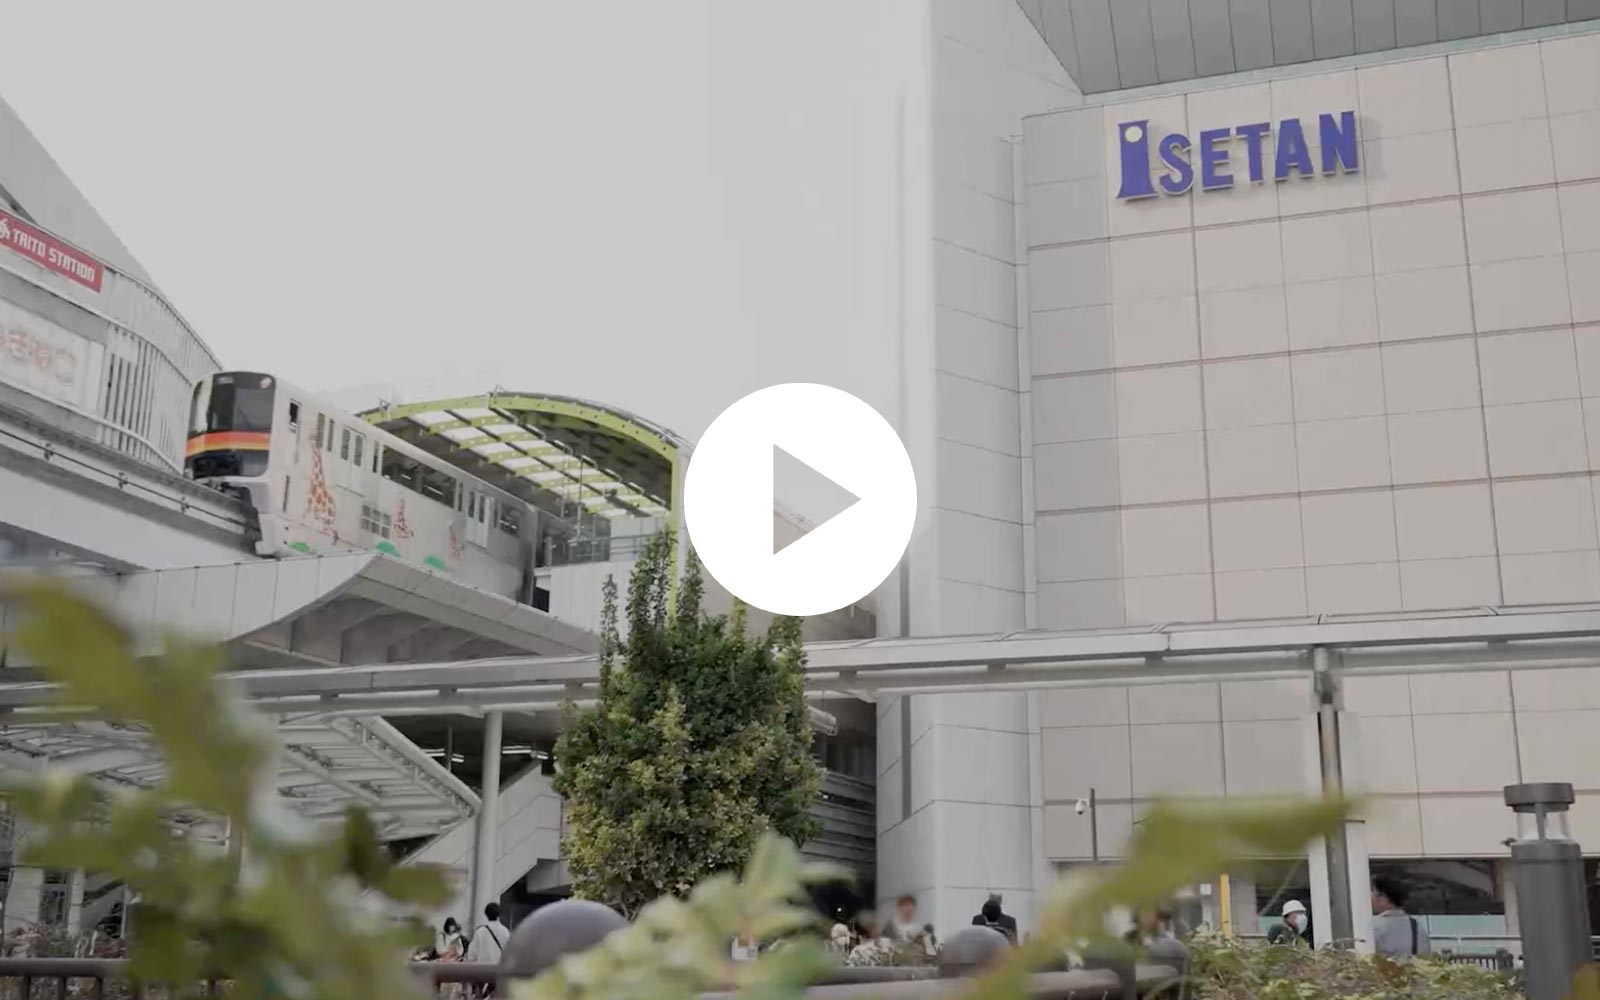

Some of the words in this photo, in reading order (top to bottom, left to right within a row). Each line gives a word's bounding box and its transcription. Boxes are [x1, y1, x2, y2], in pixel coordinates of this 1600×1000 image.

[1116, 111, 1359, 200] ISETAN
[13, 228, 46, 257] TAITO
[48, 247, 95, 282] STATION
